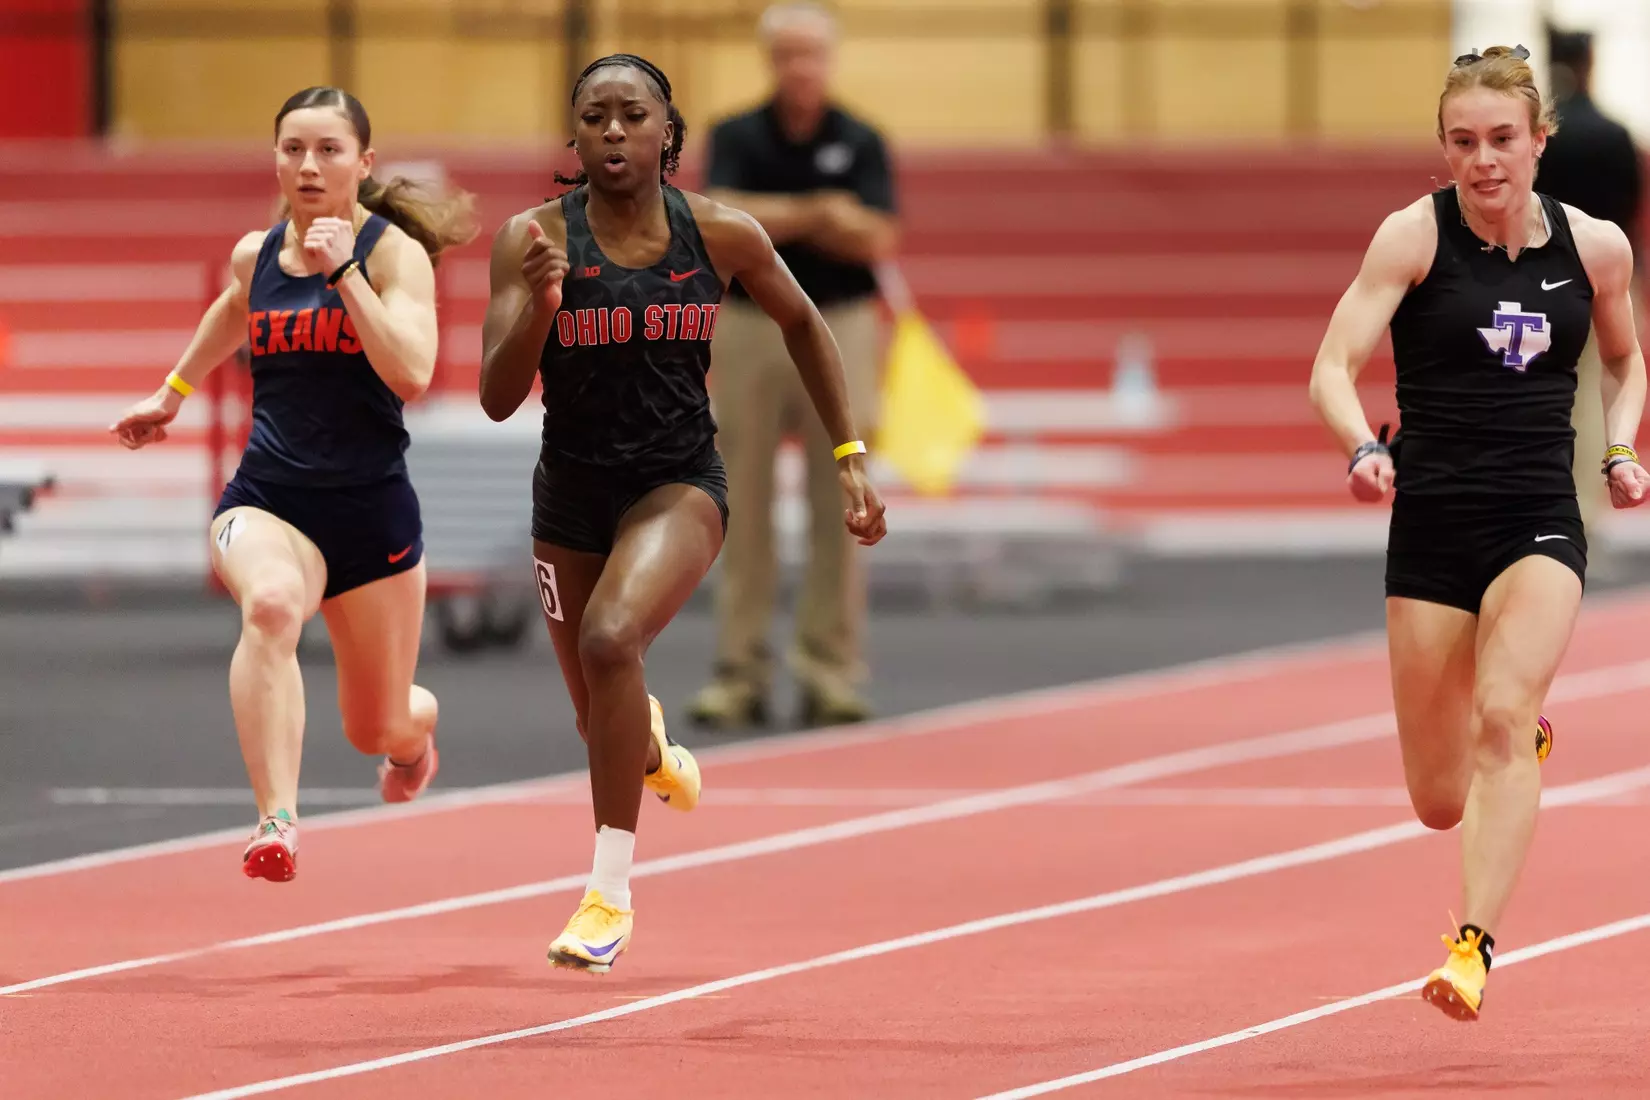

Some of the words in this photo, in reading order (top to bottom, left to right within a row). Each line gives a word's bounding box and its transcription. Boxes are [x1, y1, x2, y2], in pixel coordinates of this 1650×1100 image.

[248, 307, 363, 357] EXANS
[556, 306, 632, 347] OHIO
[1493, 309, 1546, 367] T
[536, 563, 557, 615] 6
